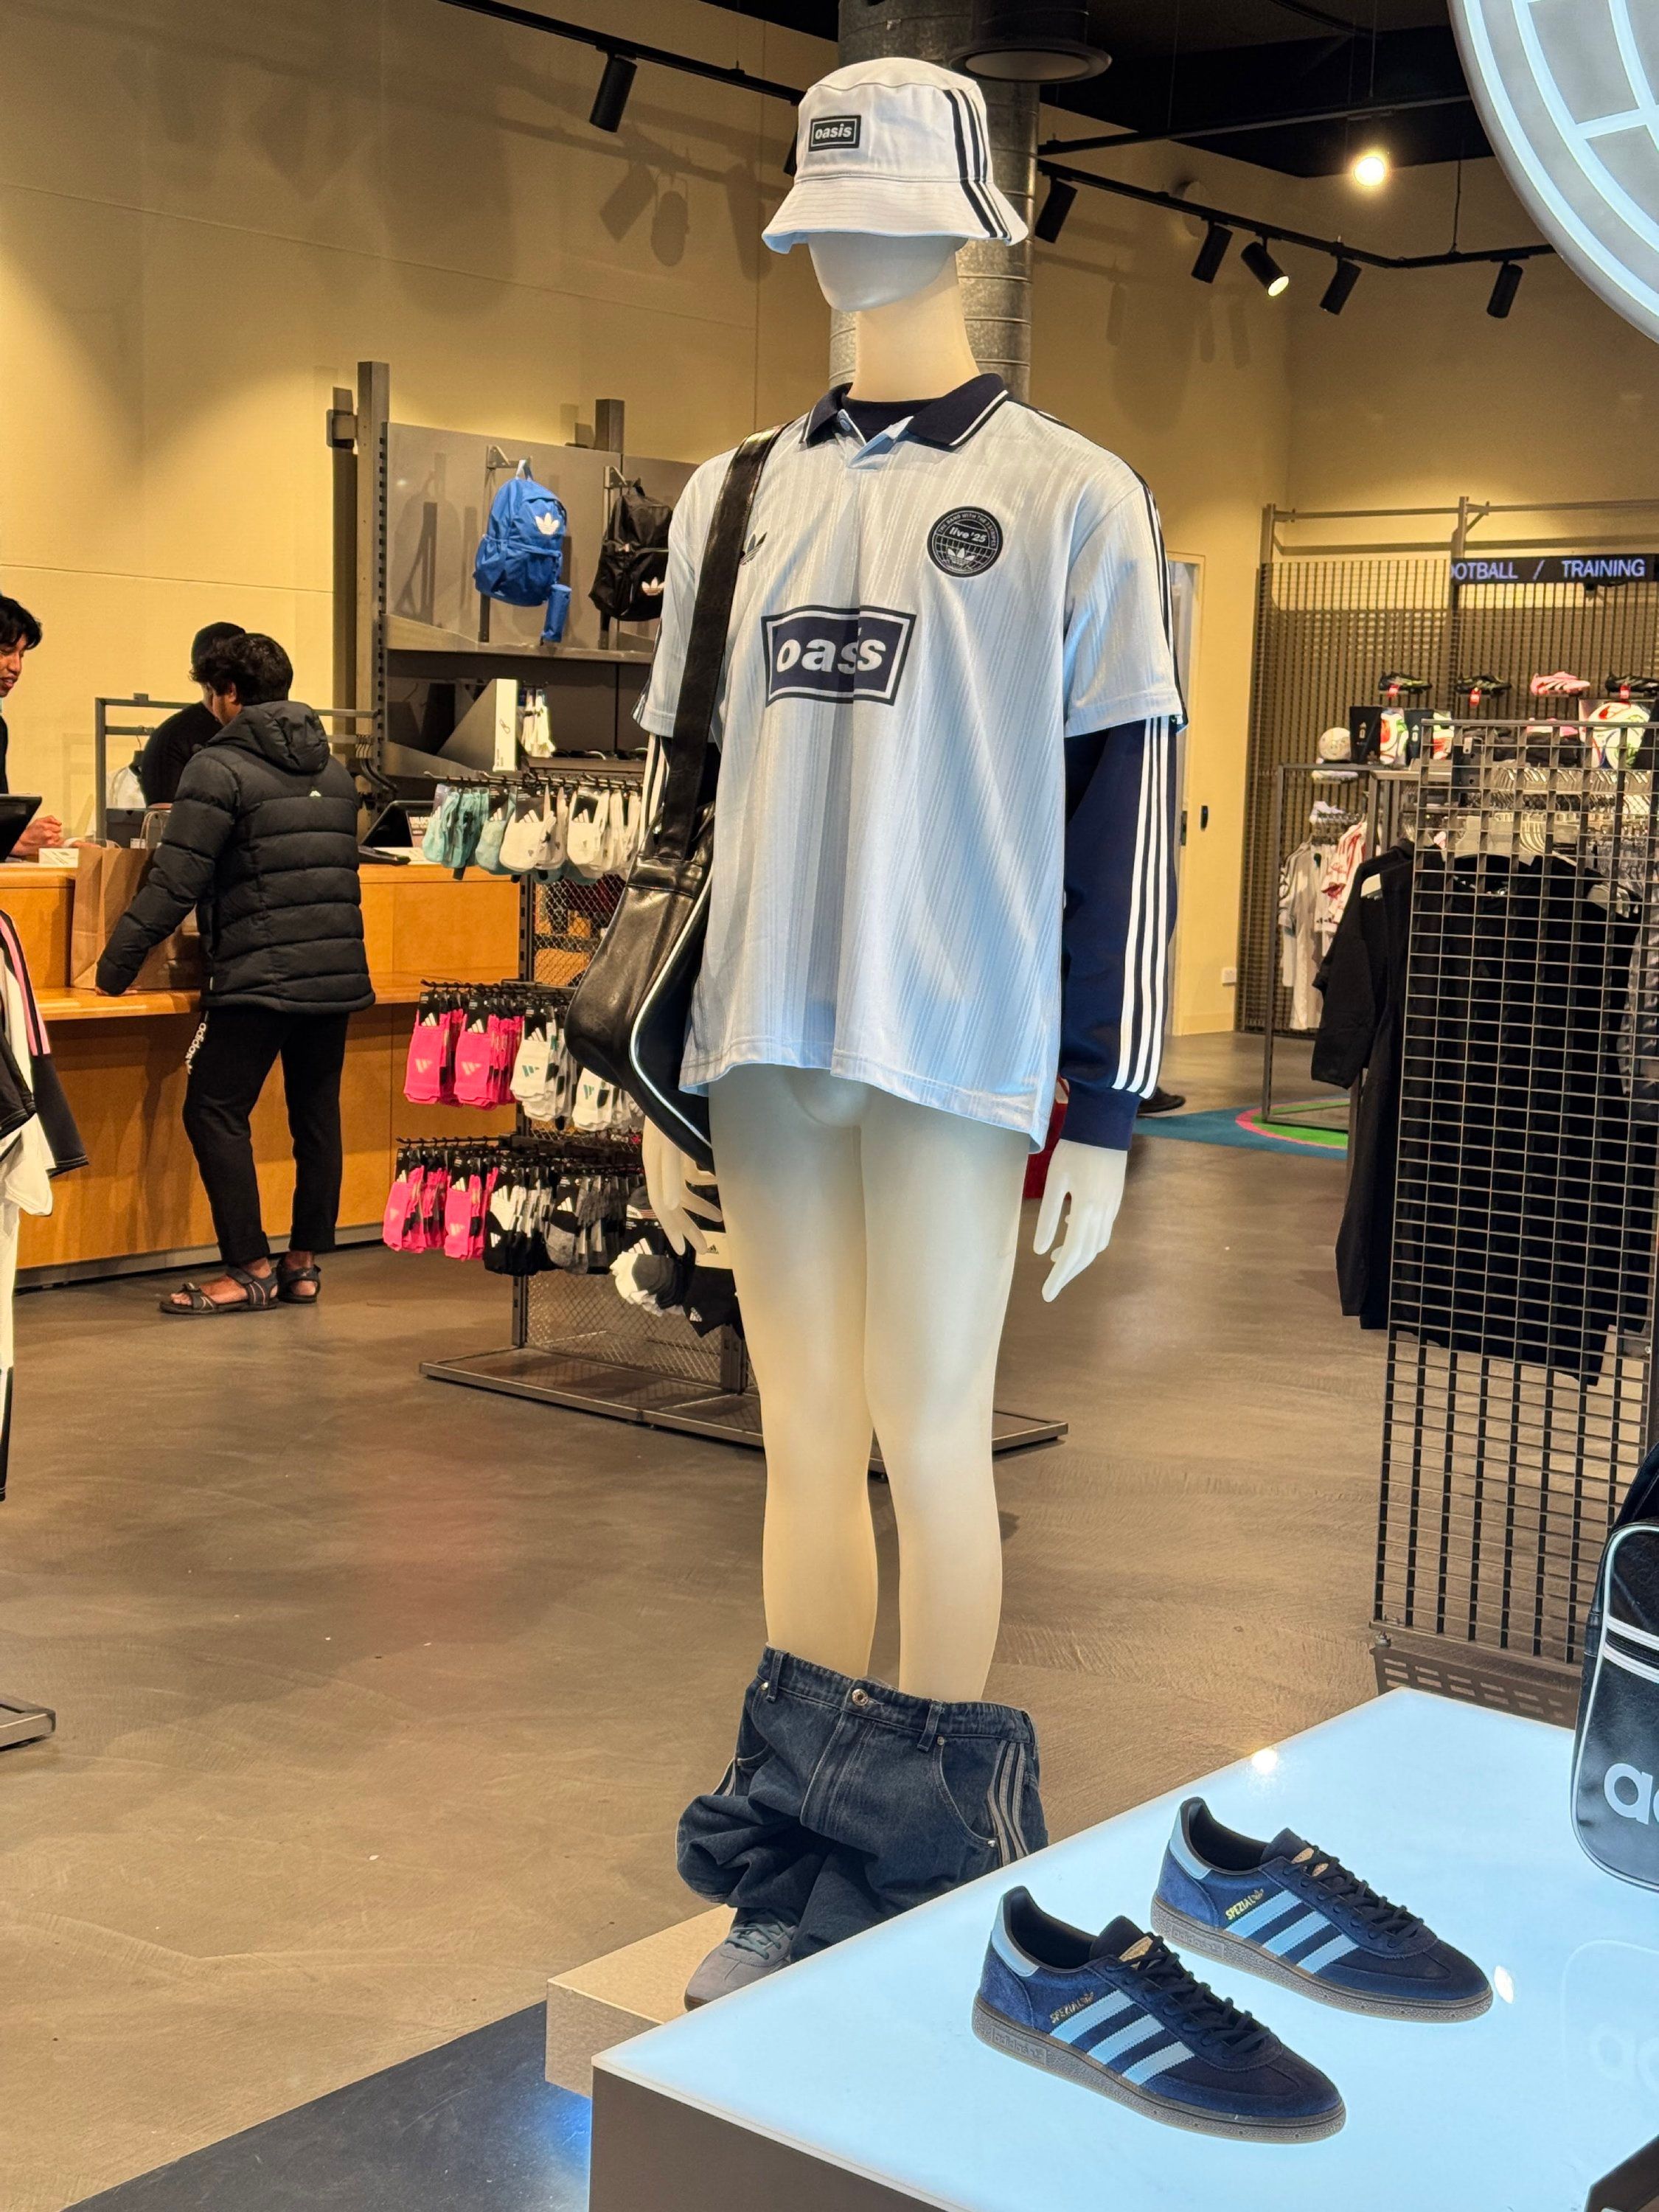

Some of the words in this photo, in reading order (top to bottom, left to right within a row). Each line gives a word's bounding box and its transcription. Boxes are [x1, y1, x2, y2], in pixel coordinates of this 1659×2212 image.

[815, 123, 852, 140] oasis
[949, 526, 970, 539] live
[970, 532, 987, 543] '25
[1561, 558, 1645, 578] TRAINING
[776, 627, 886, 675] oass
[185, 1022, 206, 1060] adidas
[1604, 1763, 1659, 1825] a
[1225, 1894, 1256, 1920] SPEZIAL
[1050, 1998, 1084, 2024] SPEZIAL
[994, 2034, 1029, 2055] adidas
